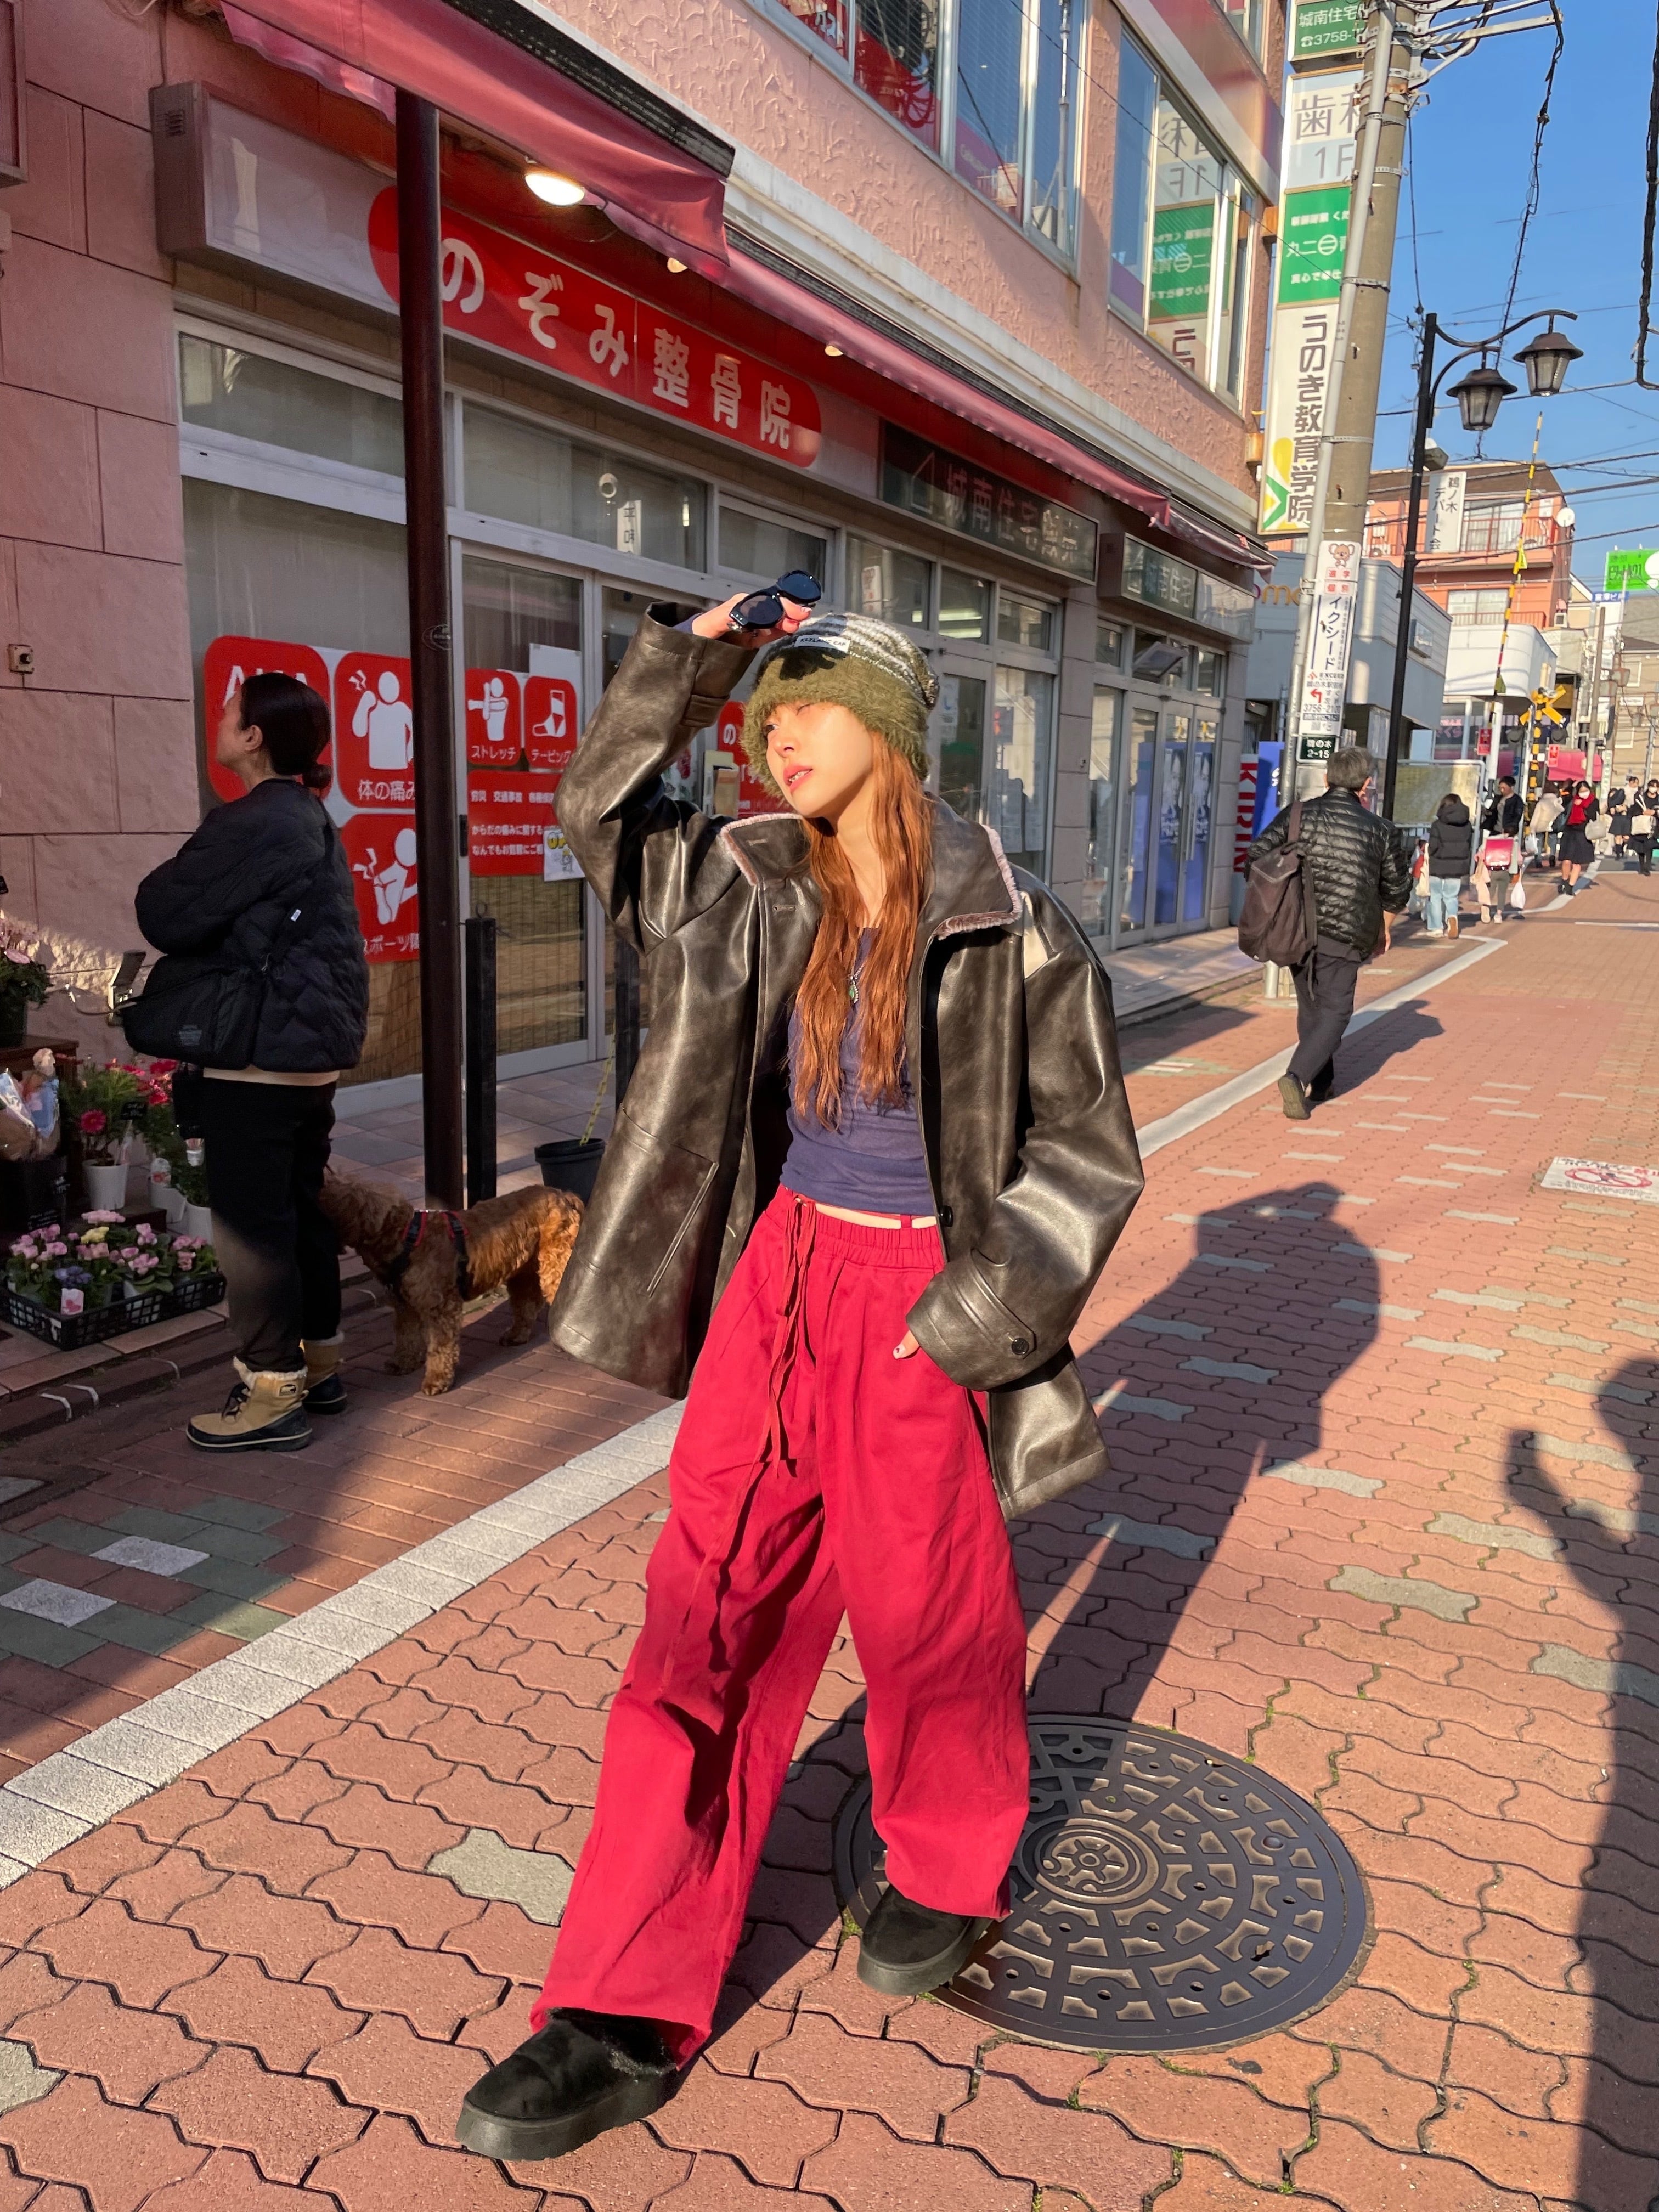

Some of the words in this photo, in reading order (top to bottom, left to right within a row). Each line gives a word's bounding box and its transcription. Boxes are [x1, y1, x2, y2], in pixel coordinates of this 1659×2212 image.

[1299, 5, 1357, 27] 城南住宅
[1314, 143, 1353, 179] 1F
[441, 238, 791, 450] のぞみ整骨院
[1286, 314, 1328, 523] うのき教育学院
[1430, 487, 1446, 550] デパート会
[1325, 596, 1342, 670] イクシード
[471, 745, 516, 760] ストレッチ
[1307, 749, 1330, 759] 2-15
[1233, 762, 1258, 872] KIRIN
